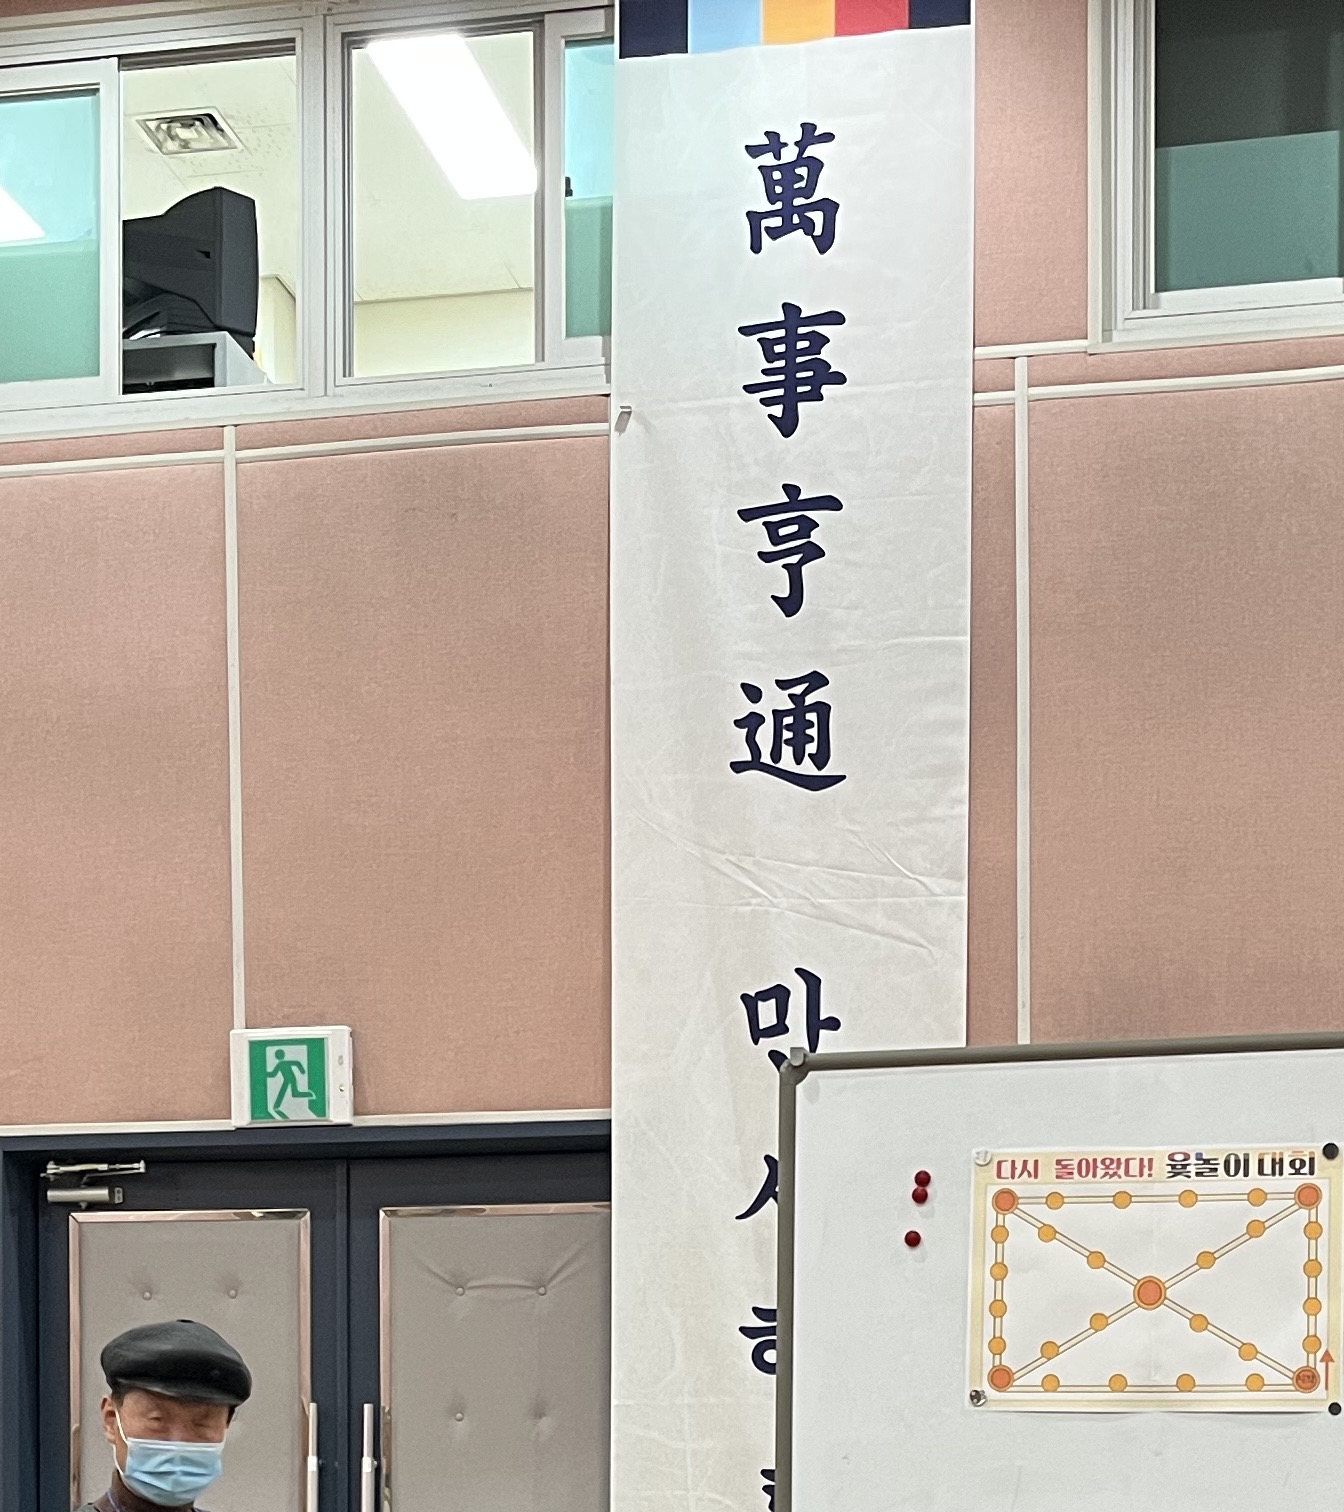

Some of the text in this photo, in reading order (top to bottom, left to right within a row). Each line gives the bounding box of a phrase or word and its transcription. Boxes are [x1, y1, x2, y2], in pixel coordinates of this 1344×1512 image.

[729, 122, 848, 791] 萬事亨通
[996, 1158, 1040, 1180] 다시
[1055, 1156, 1154, 1180] 돌아왔다!
